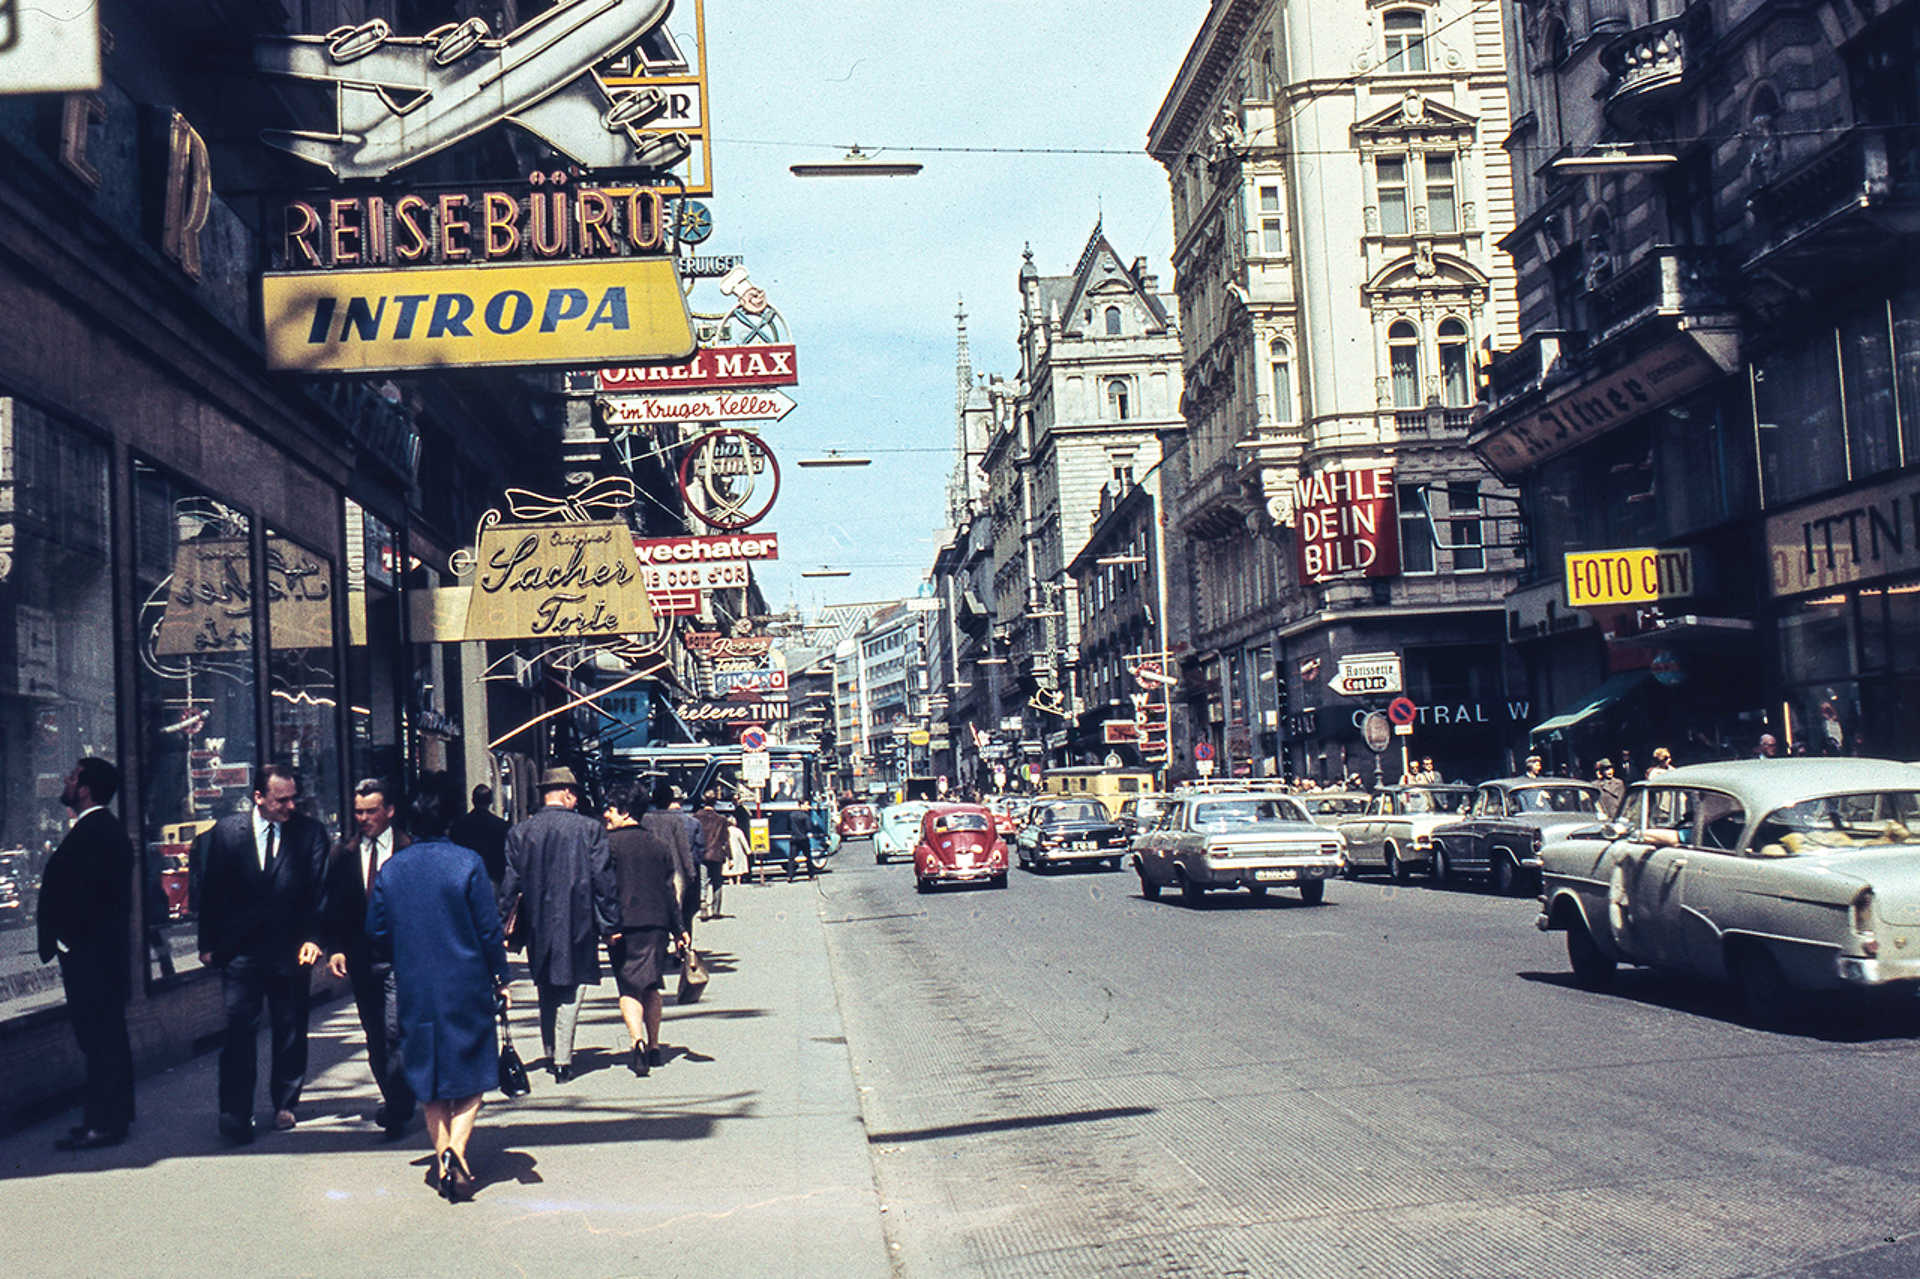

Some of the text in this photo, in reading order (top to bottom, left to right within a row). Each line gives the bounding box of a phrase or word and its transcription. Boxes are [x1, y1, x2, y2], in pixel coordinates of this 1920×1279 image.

[284, 170, 664, 267] REISEBÜRO
[308, 286, 630, 345] INTROPA
[715, 351, 794, 379] MAX
[620, 403, 643, 420] im
[716, 395, 781, 416] Keller
[1303, 503, 1376, 542] DEIN
[481, 534, 635, 595] Sacher
[1305, 539, 1377, 576] BILD
[1572, 552, 1690, 600] FOTO CITY
[531, 593, 619, 634] Torte
[749, 702, 790, 719] TINI
[1351, 703, 1489, 729] CTRAL
